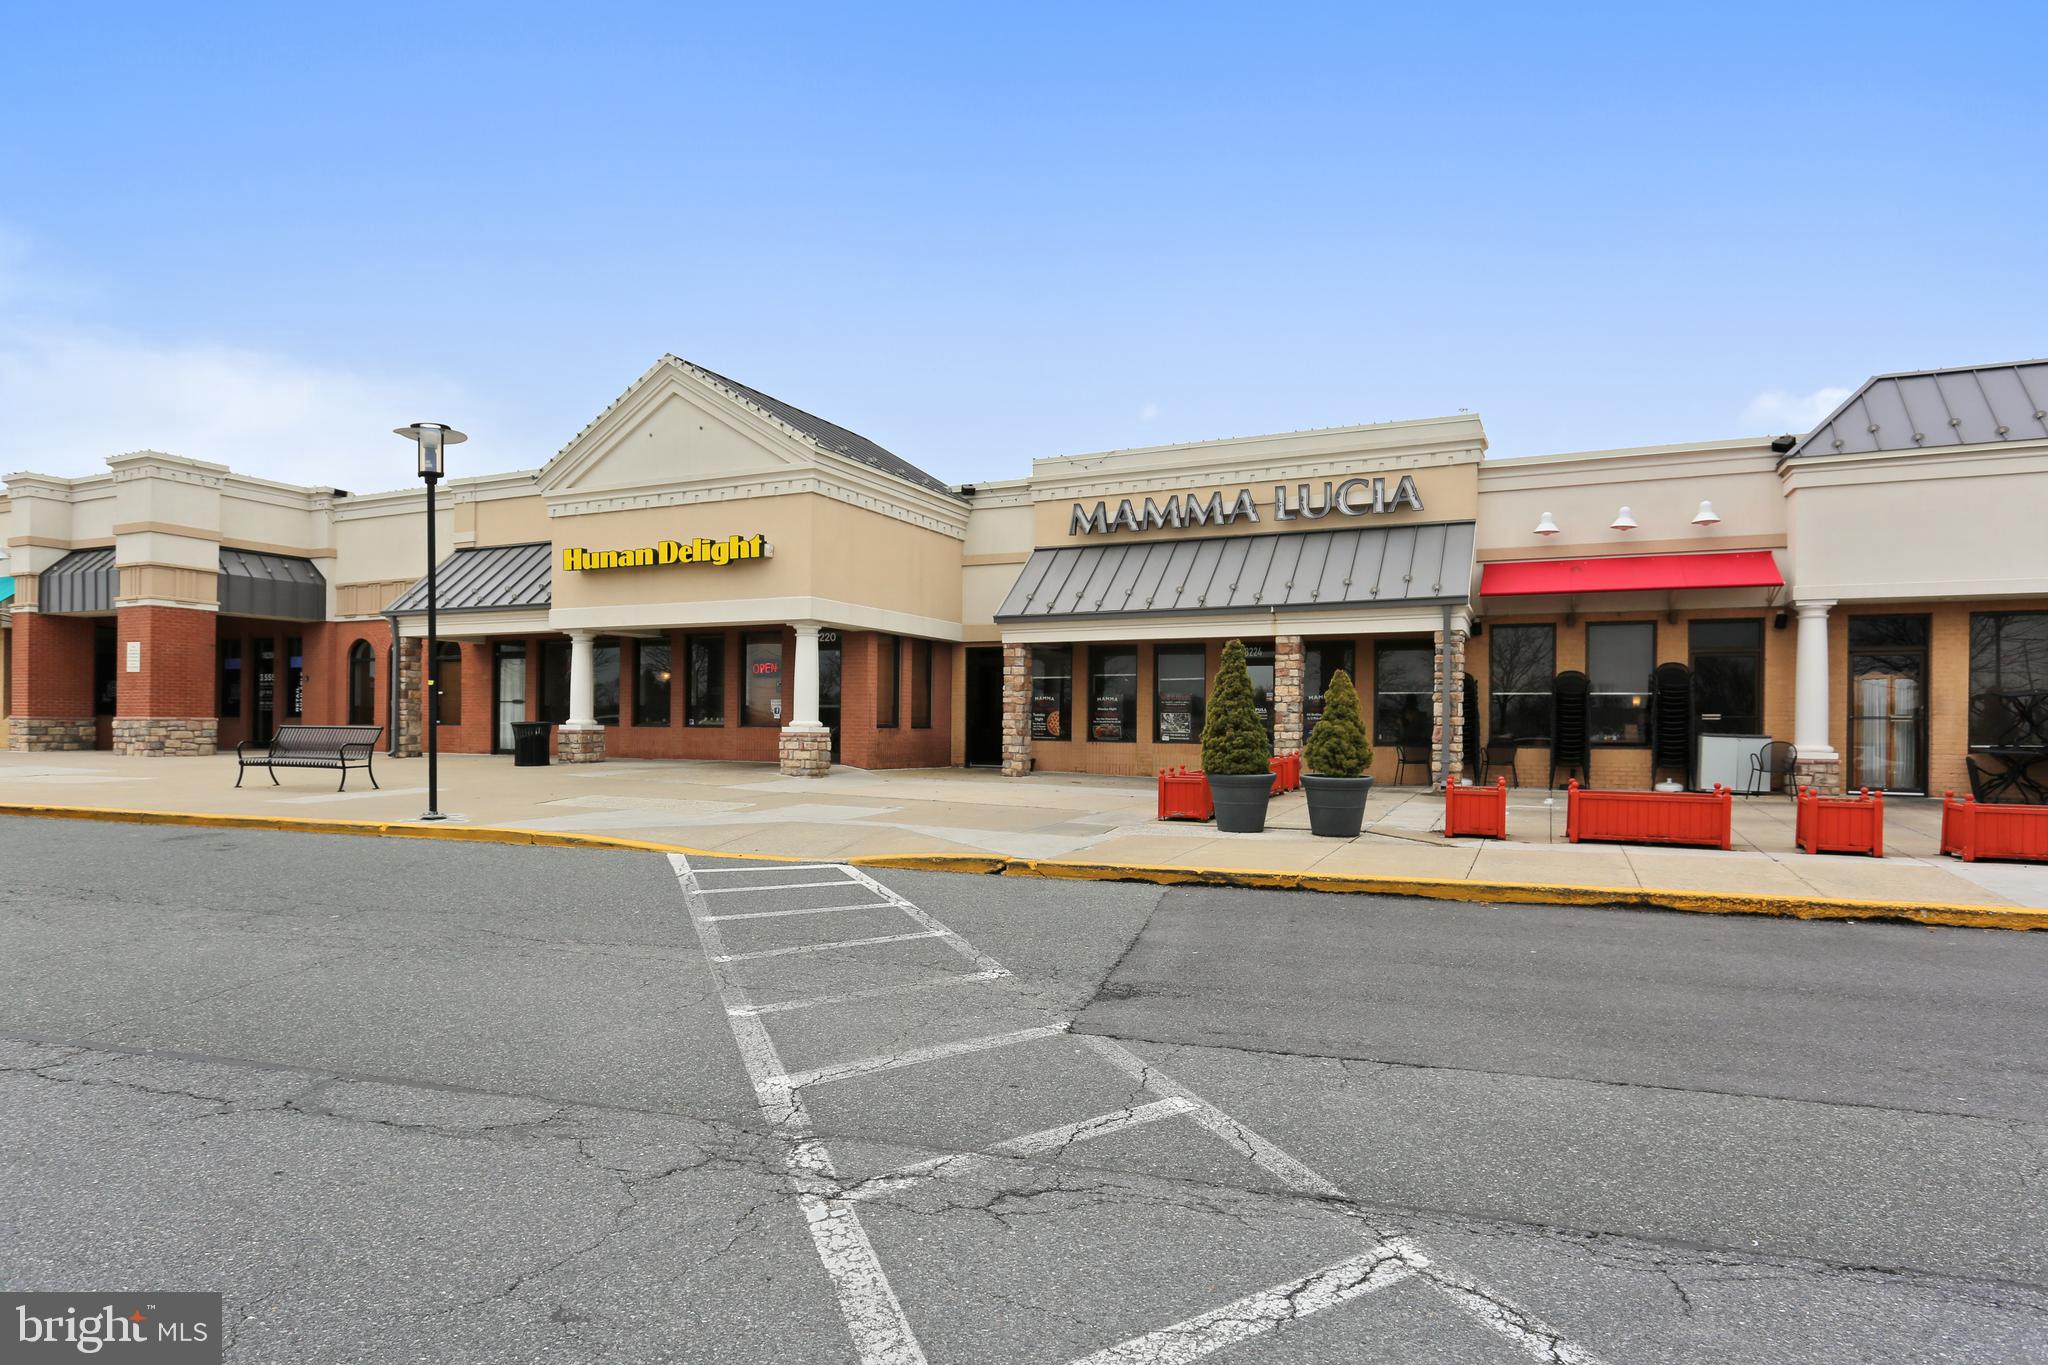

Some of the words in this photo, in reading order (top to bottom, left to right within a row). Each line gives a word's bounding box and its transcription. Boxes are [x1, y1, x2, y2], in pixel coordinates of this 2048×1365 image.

[1069, 488, 1260, 536] MAMMA
[1274, 475, 1425, 521] LUCIA
[563, 547, 656, 571] Hunan
[658, 534, 765, 566] Delight
[752, 663, 778, 674] OPEN
